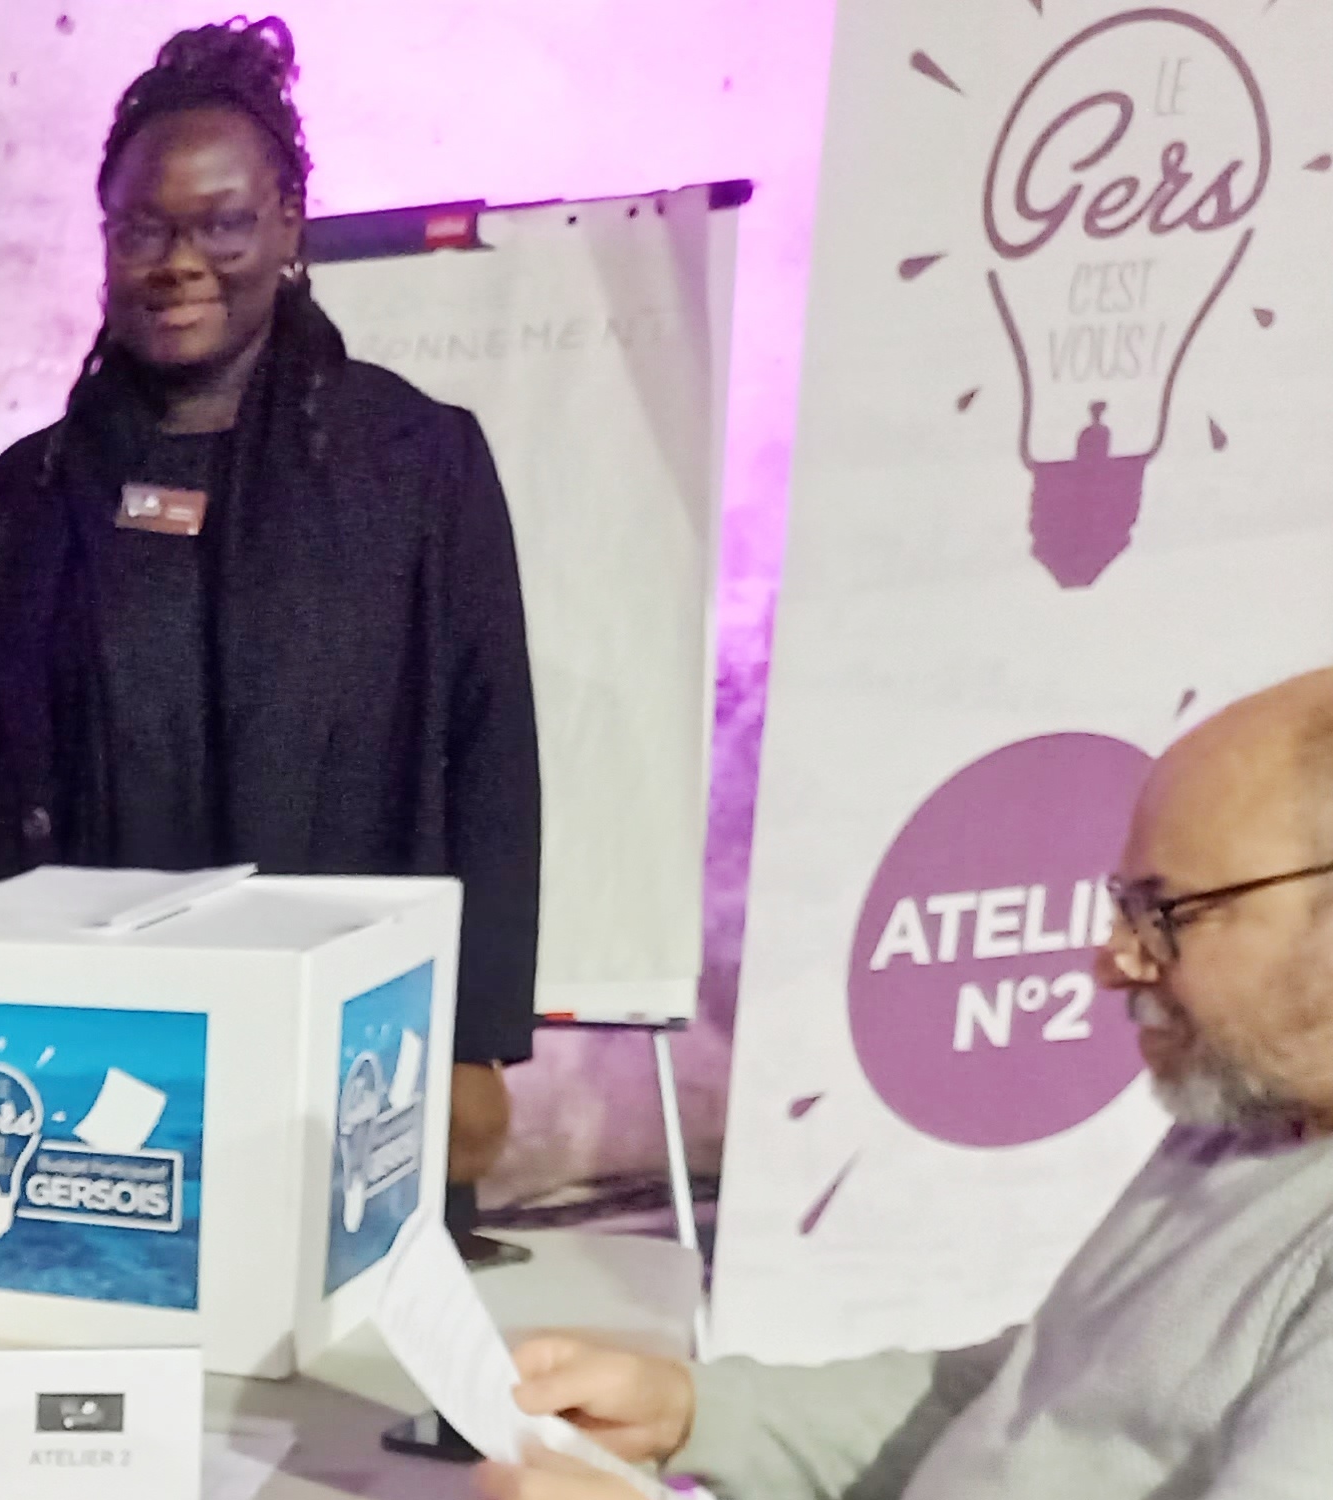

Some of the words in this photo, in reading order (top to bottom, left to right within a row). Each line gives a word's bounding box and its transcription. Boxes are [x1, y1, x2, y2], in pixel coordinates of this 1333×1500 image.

[1152, 56, 1192, 117] LE
[1013, 90, 1245, 242] Gers
[1067, 256, 1158, 315] C'EST
[25, 1173, 169, 1216] GERSOIS
[29, 1449, 115, 1467] ATELIER
